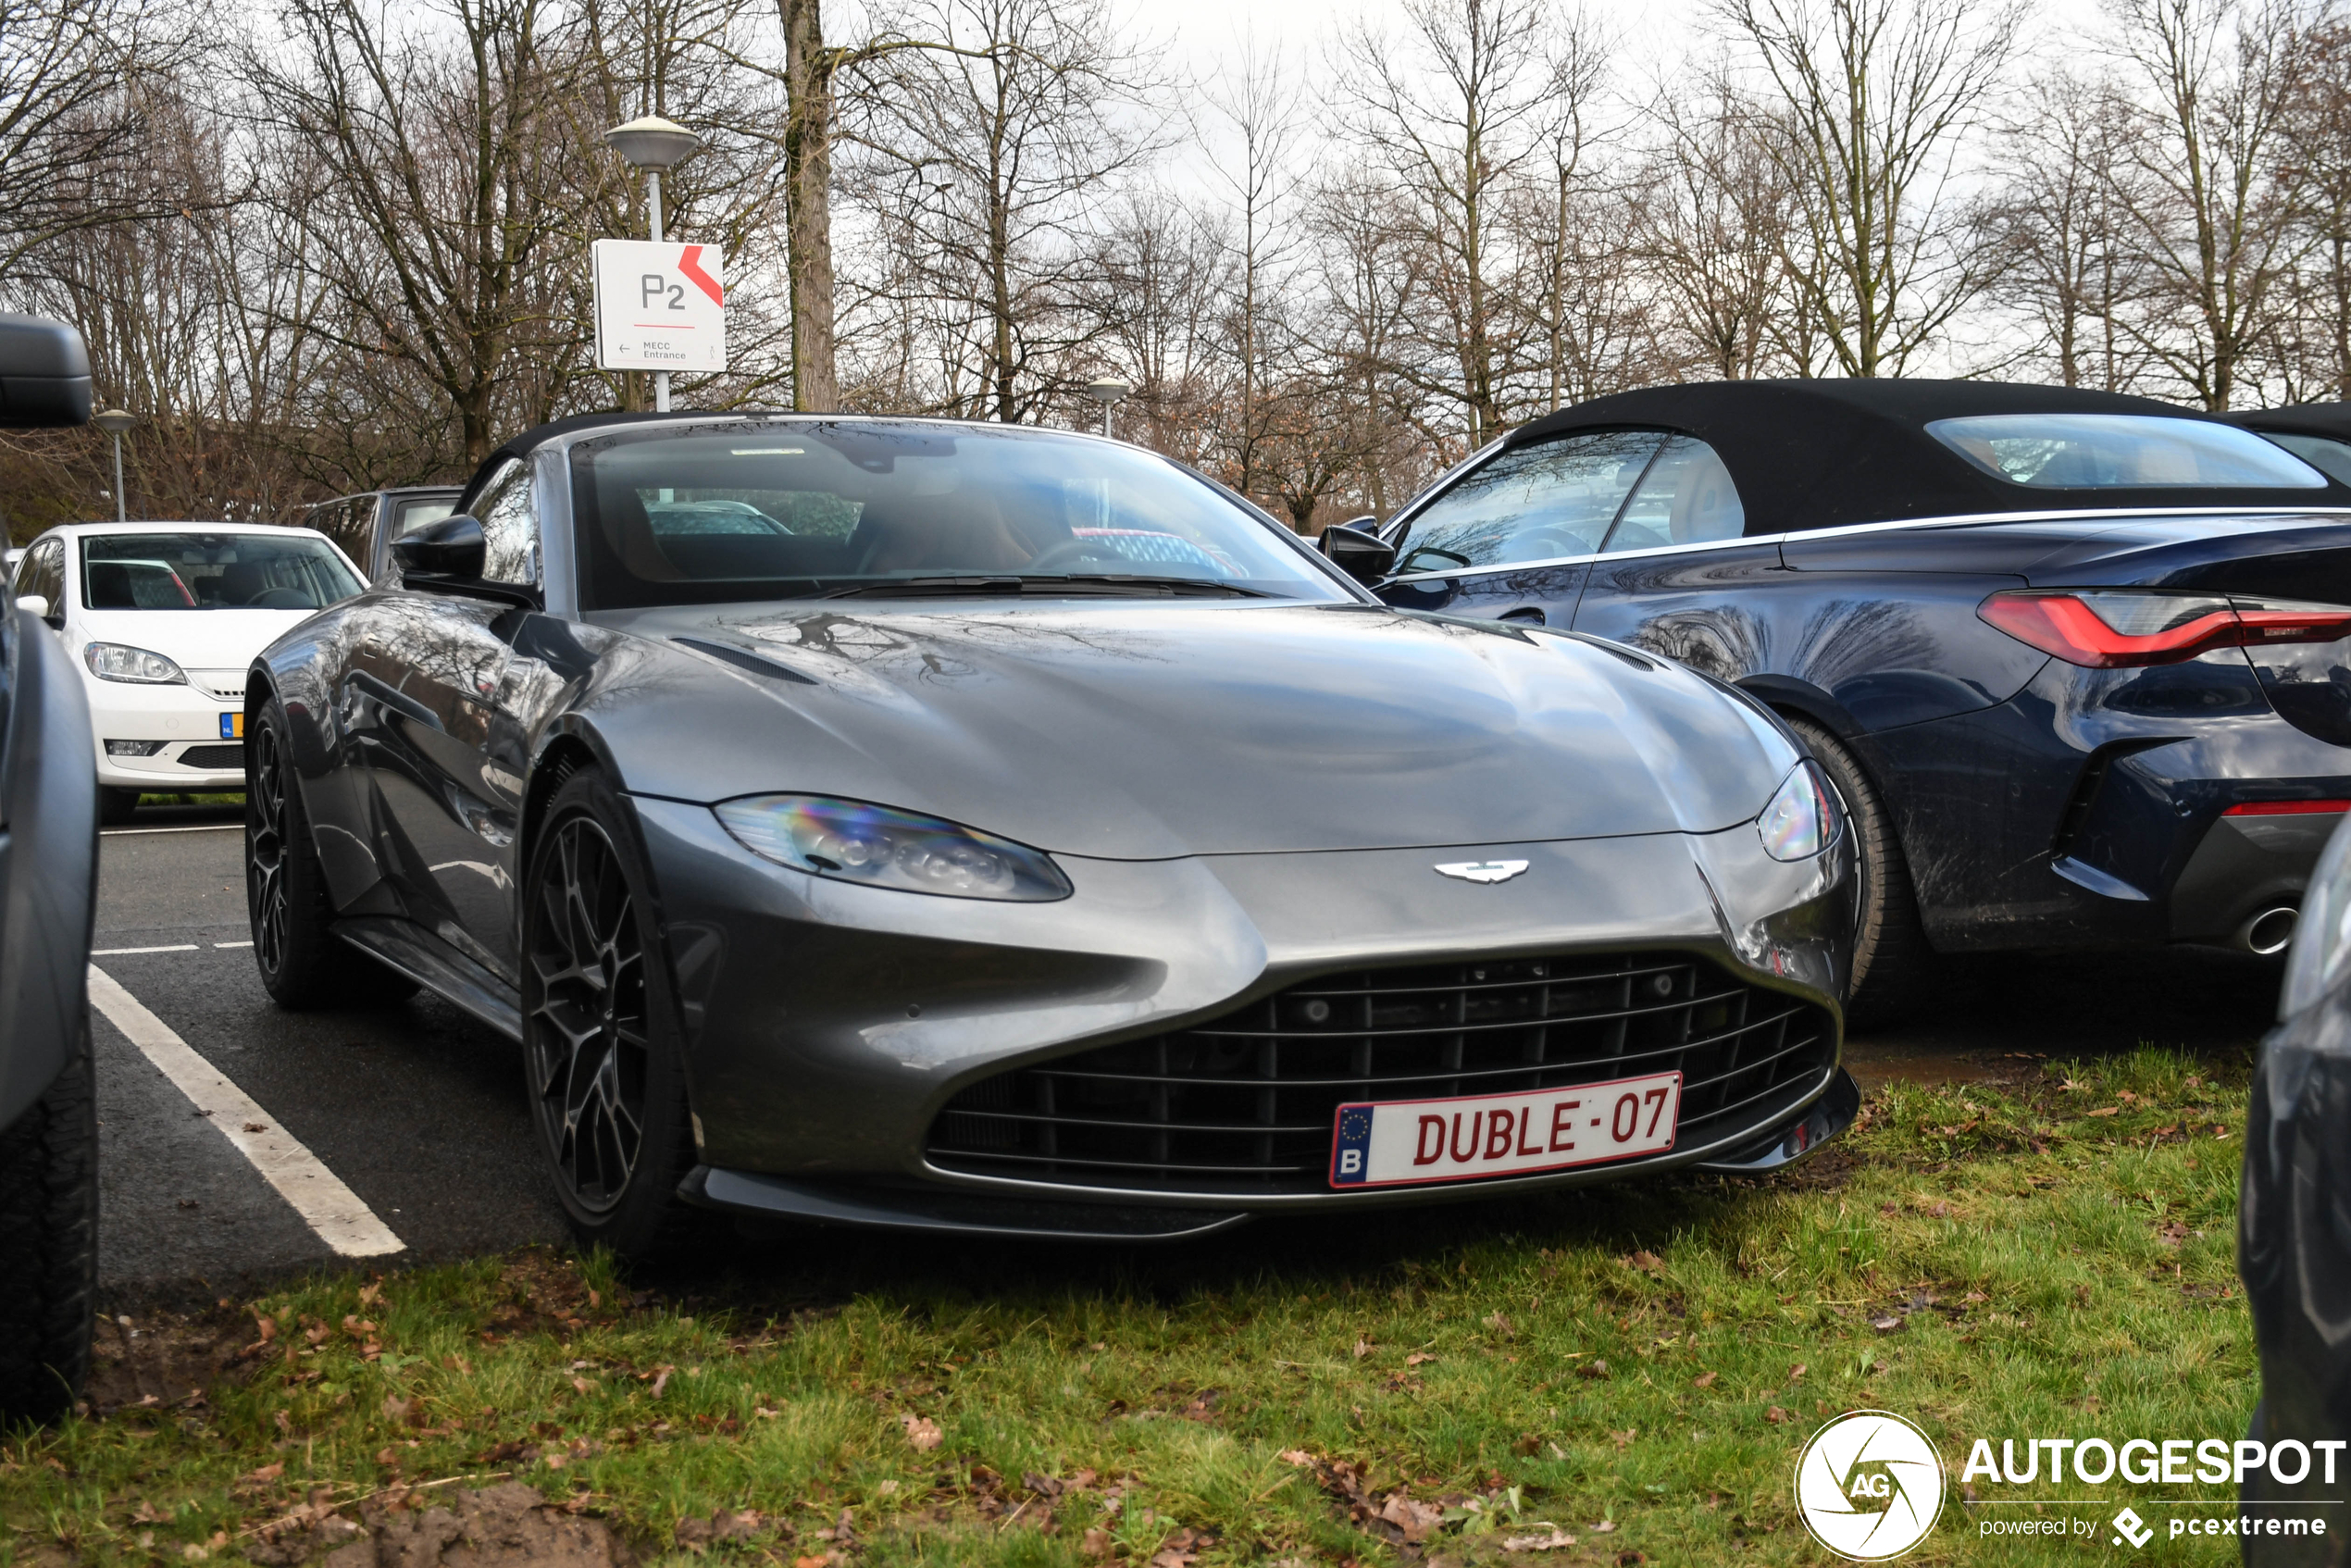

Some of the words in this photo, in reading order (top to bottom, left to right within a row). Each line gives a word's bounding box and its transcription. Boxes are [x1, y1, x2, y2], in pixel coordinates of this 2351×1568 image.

[641, 274, 686, 310] P2
[643, 342, 671, 350] MECC
[643, 351, 686, 360] Entrance
[1340, 1149, 1362, 1174] B
